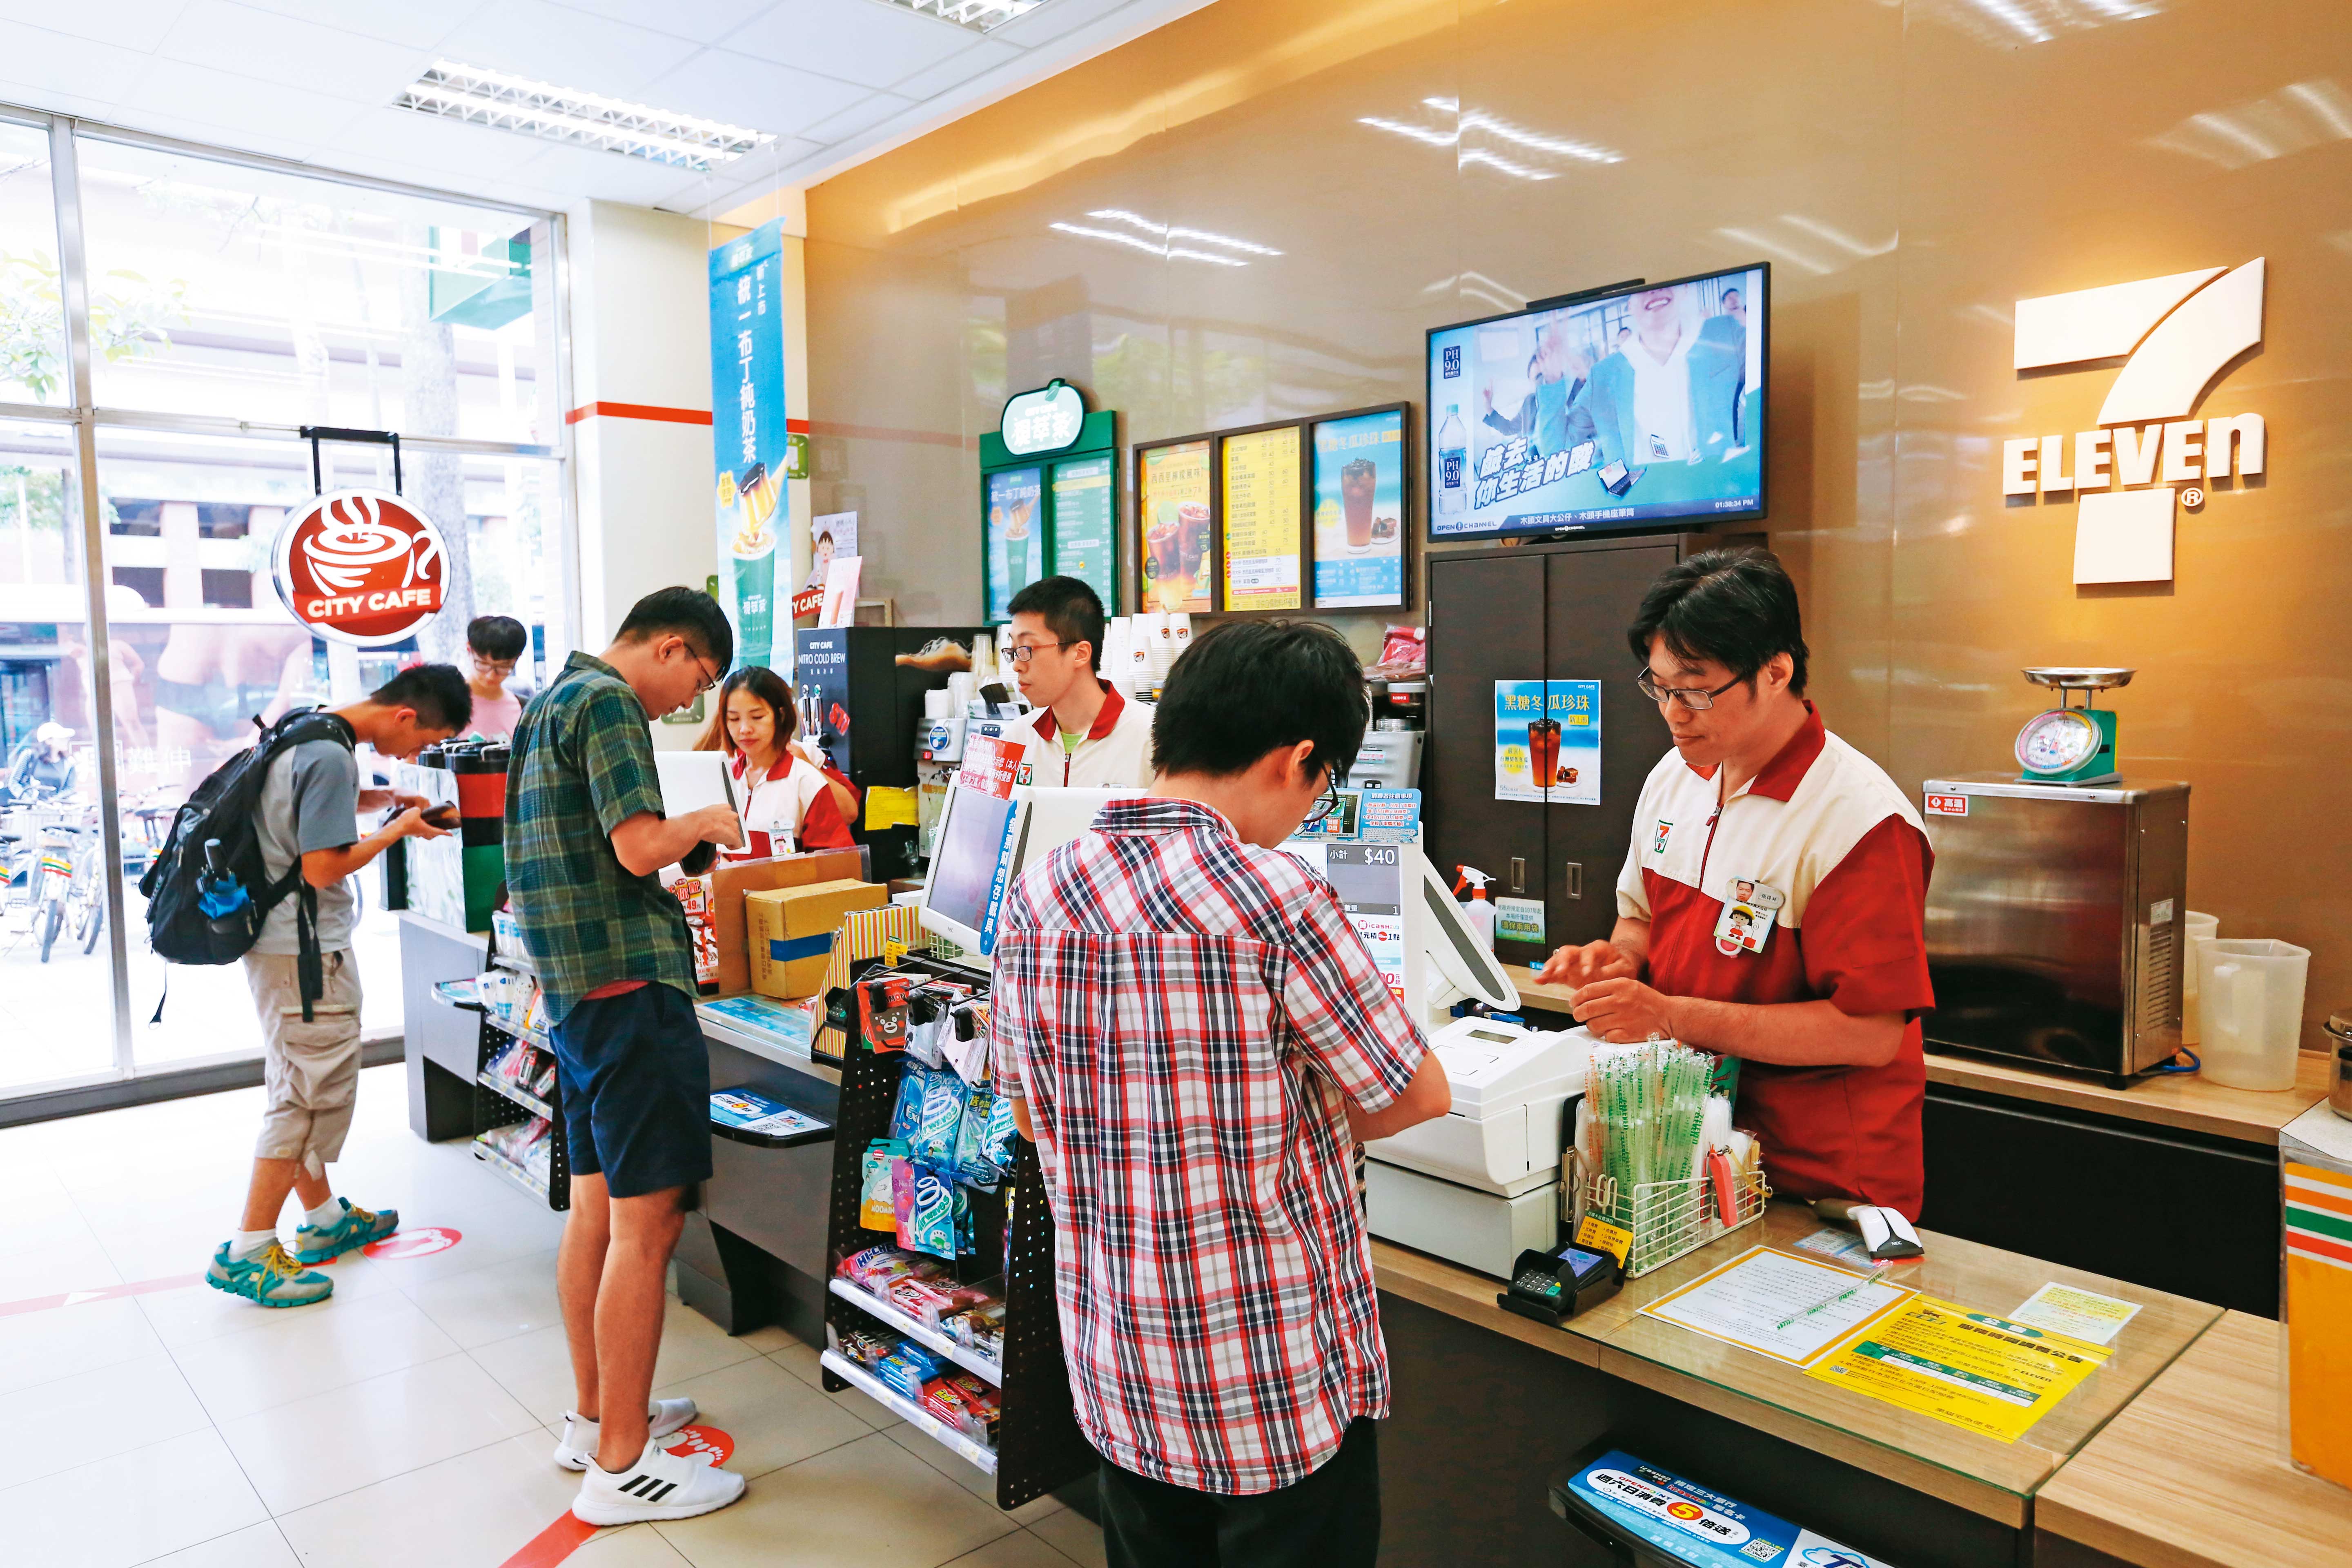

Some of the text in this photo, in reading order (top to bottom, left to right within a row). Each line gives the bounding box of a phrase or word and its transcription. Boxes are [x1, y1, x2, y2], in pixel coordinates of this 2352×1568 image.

[1446, 350, 1459, 360] PH
[737, 274, 757, 463] 統一布丁純奶茶
[1445, 359, 1460, 372] 9.0
[1446, 460, 1459, 471] PH
[1446, 470, 1459, 481] 9.0
[1474, 439, 1595, 509] 你生活的酸
[1715, 499, 1740, 508] 01:38:34
[307, 588, 431, 618] CITY CAFE
[800, 593, 823, 612] CAFE
[809, 641, 833, 650] CITY CAFE
[798, 652, 846, 665] NITRO COLD BREW
[1504, 694, 1590, 711] 黑糖冬瓜珍珠
[1329, 846, 1395, 865] 小計 $40
[1392, 906, 1399, 915] 1
[1501, 920, 1539, 933] 環保兩用袋
[871, 1204, 895, 1214] MOOMIN
[1958, 1323, 2083, 1363] 服務時間調整公告
[1595, 1473, 1667, 1507] 週六日消費
[1674, 1479, 1737, 1509] 指定三大銀行
[1671, 1503, 1700, 1519] 5
[1698, 1518, 1731, 1536] 倍送
